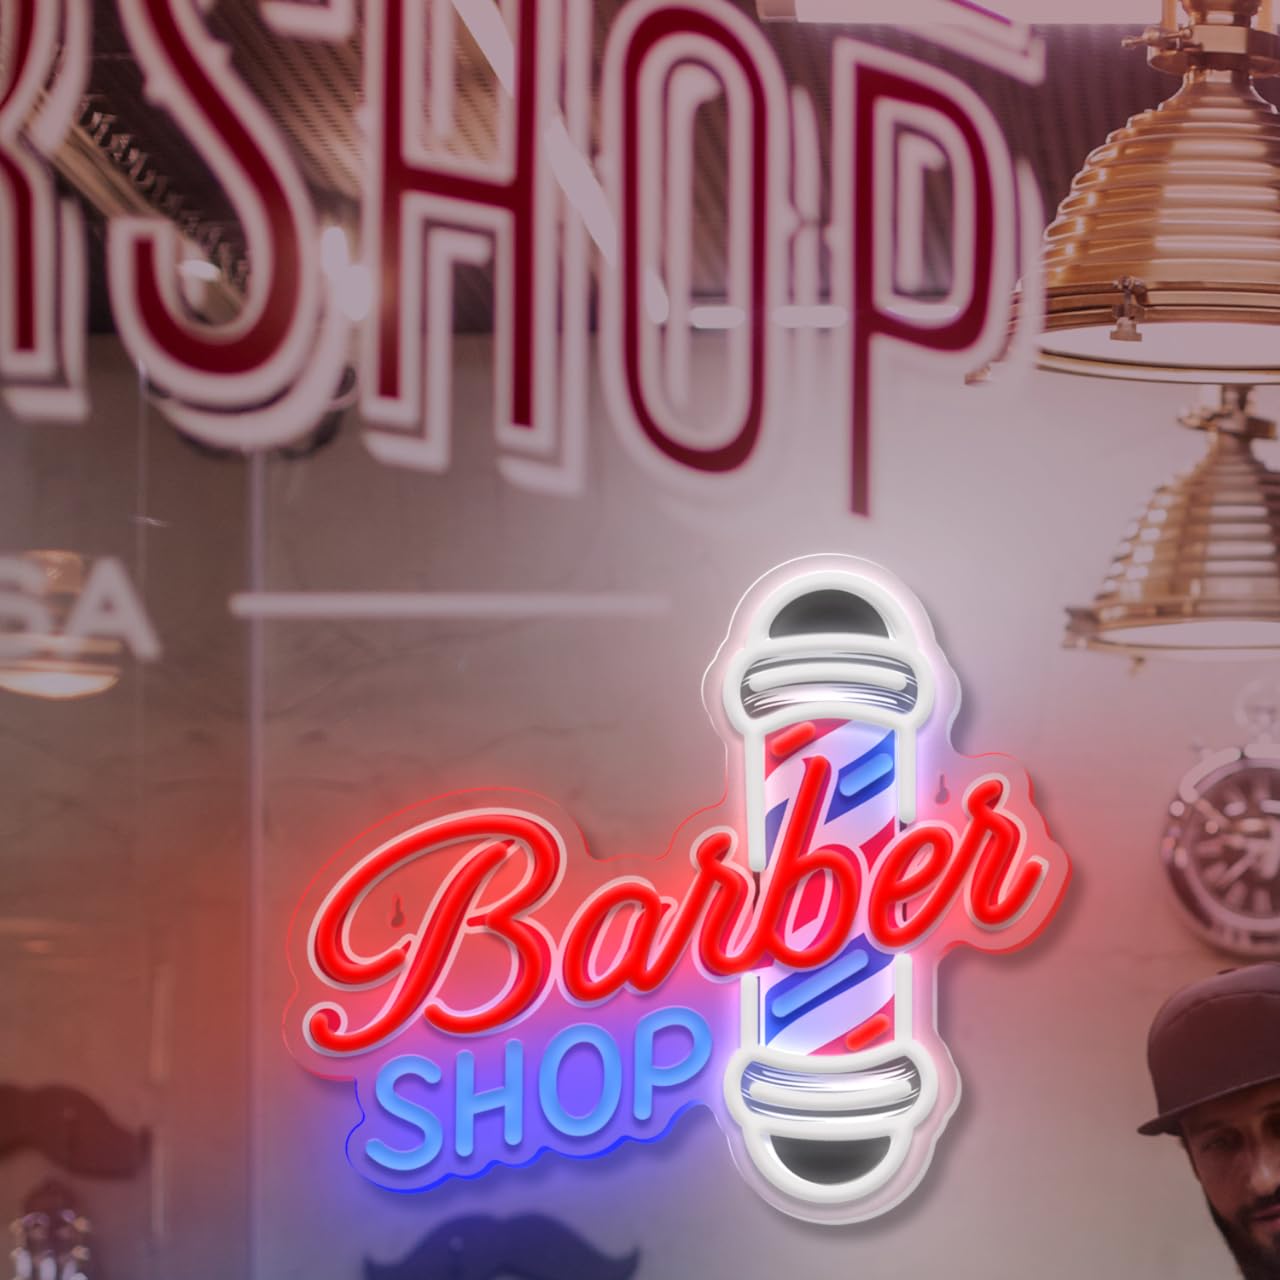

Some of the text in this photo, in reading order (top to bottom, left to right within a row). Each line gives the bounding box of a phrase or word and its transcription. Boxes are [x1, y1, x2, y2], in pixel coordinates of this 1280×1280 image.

[0, 0, 1040, 522] SHOP
[304, 752, 1048, 1056] Barber
[364, 1005, 714, 1172] SHOP
